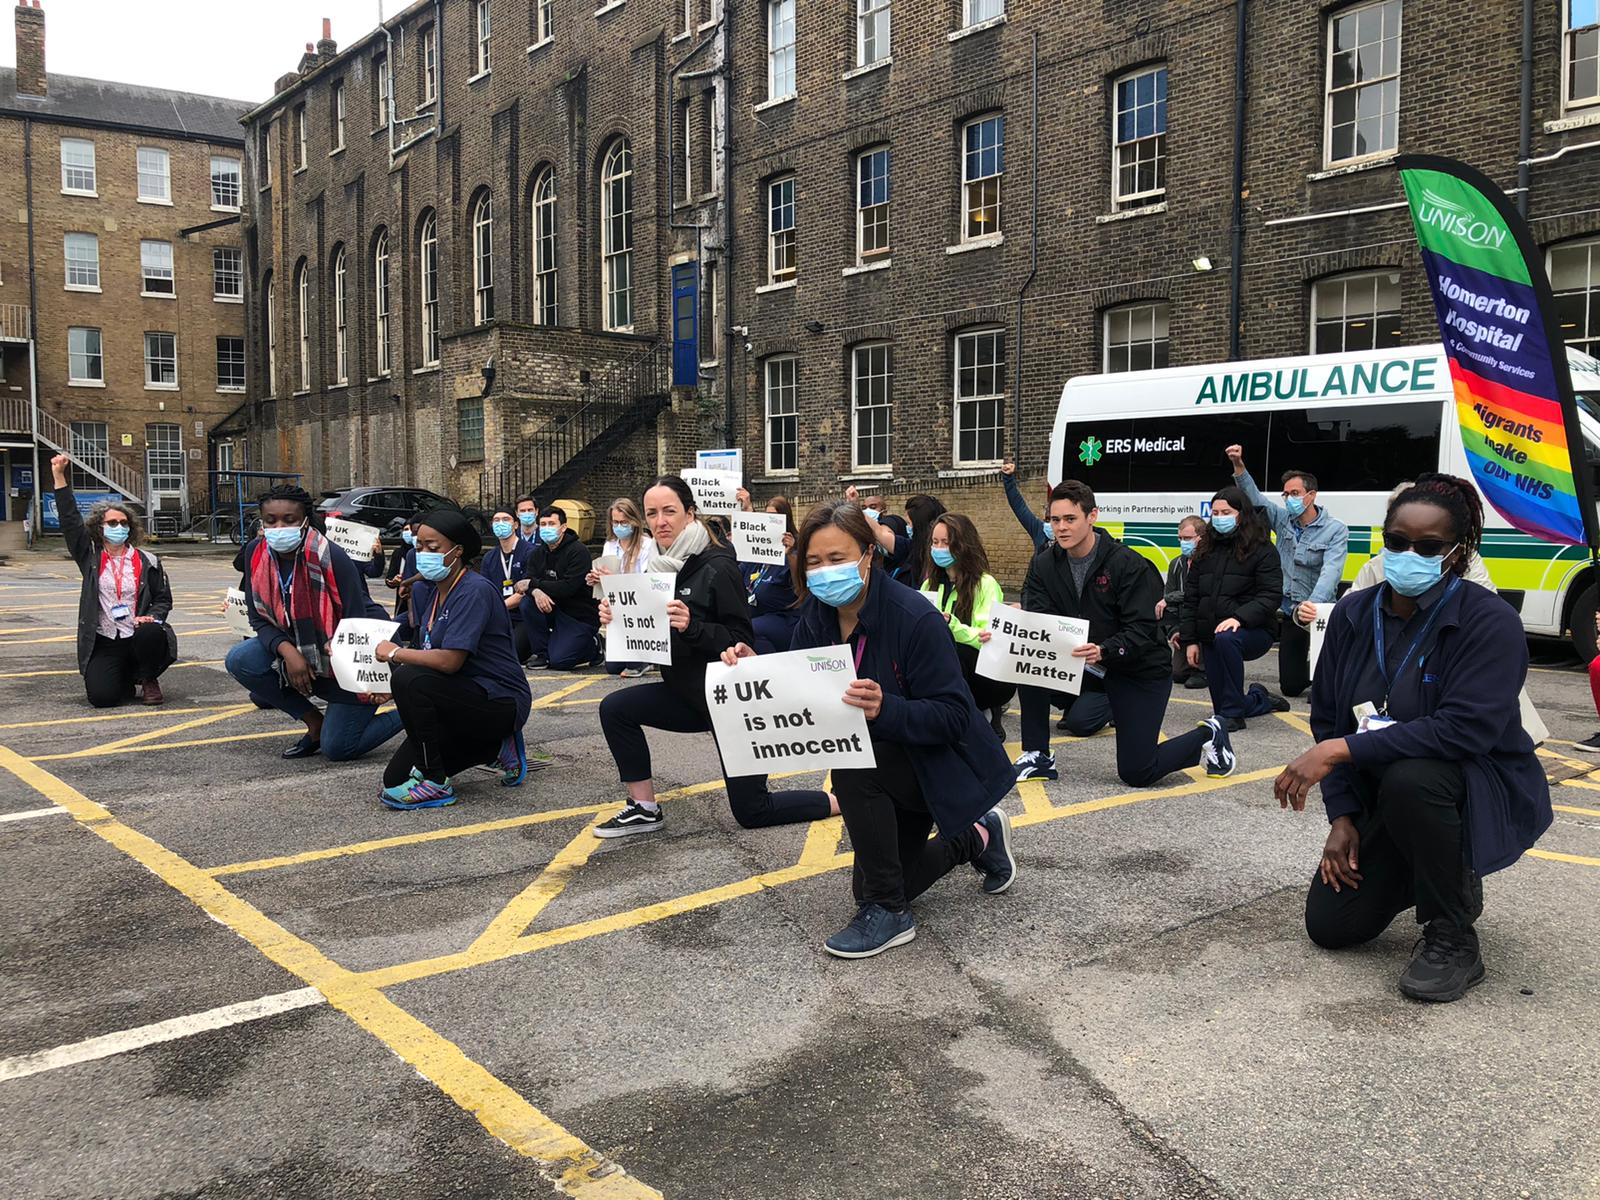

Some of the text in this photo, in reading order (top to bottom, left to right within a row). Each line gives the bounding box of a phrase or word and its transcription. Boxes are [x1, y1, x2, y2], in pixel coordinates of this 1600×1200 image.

[1419, 203, 1506, 248] UNISON
[1439, 275, 1531, 325] Homerton
[1445, 308, 1524, 352] Hospital
[1498, 360, 1536, 379] Services
[1195, 357, 1438, 405] AMBULANCE
[1105, 436, 1186, 454] ERS Medical
[691, 477, 720, 486] Black
[1515, 472, 1555, 500] NHS
[698, 489, 725, 498] Lives
[703, 500, 738, 509] Matter
[1098, 504, 1122, 515] orking
[1123, 504, 1131, 513] in
[1131, 504, 1176, 515] Partnership
[1177, 504, 1194, 513] with
[335, 526, 349, 534] UK
[740, 521, 767, 532] Black
[344, 538, 359, 546] not
[746, 534, 772, 544] Lives
[345, 547, 371, 558] ocent
[751, 547, 783, 557] Matter
[608, 591, 637, 606] # UK
[623, 614, 655, 629] is not
[1316, 618, 1326, 631] #
[991, 617, 1052, 643] # Black
[1058, 624, 1084, 635] UNISON
[337, 631, 370, 645] # Black
[626, 635, 668, 653] innocent
[353, 650, 373, 664] Lives
[1009, 642, 1057, 661] Lives
[810, 659, 848, 672] UNISON
[1016, 661, 1077, 682] Matter
[356, 669, 388, 682] Matter
[713, 679, 773, 704] # UK
[743, 708, 815, 731] is not
[752, 733, 862, 759] innocent
